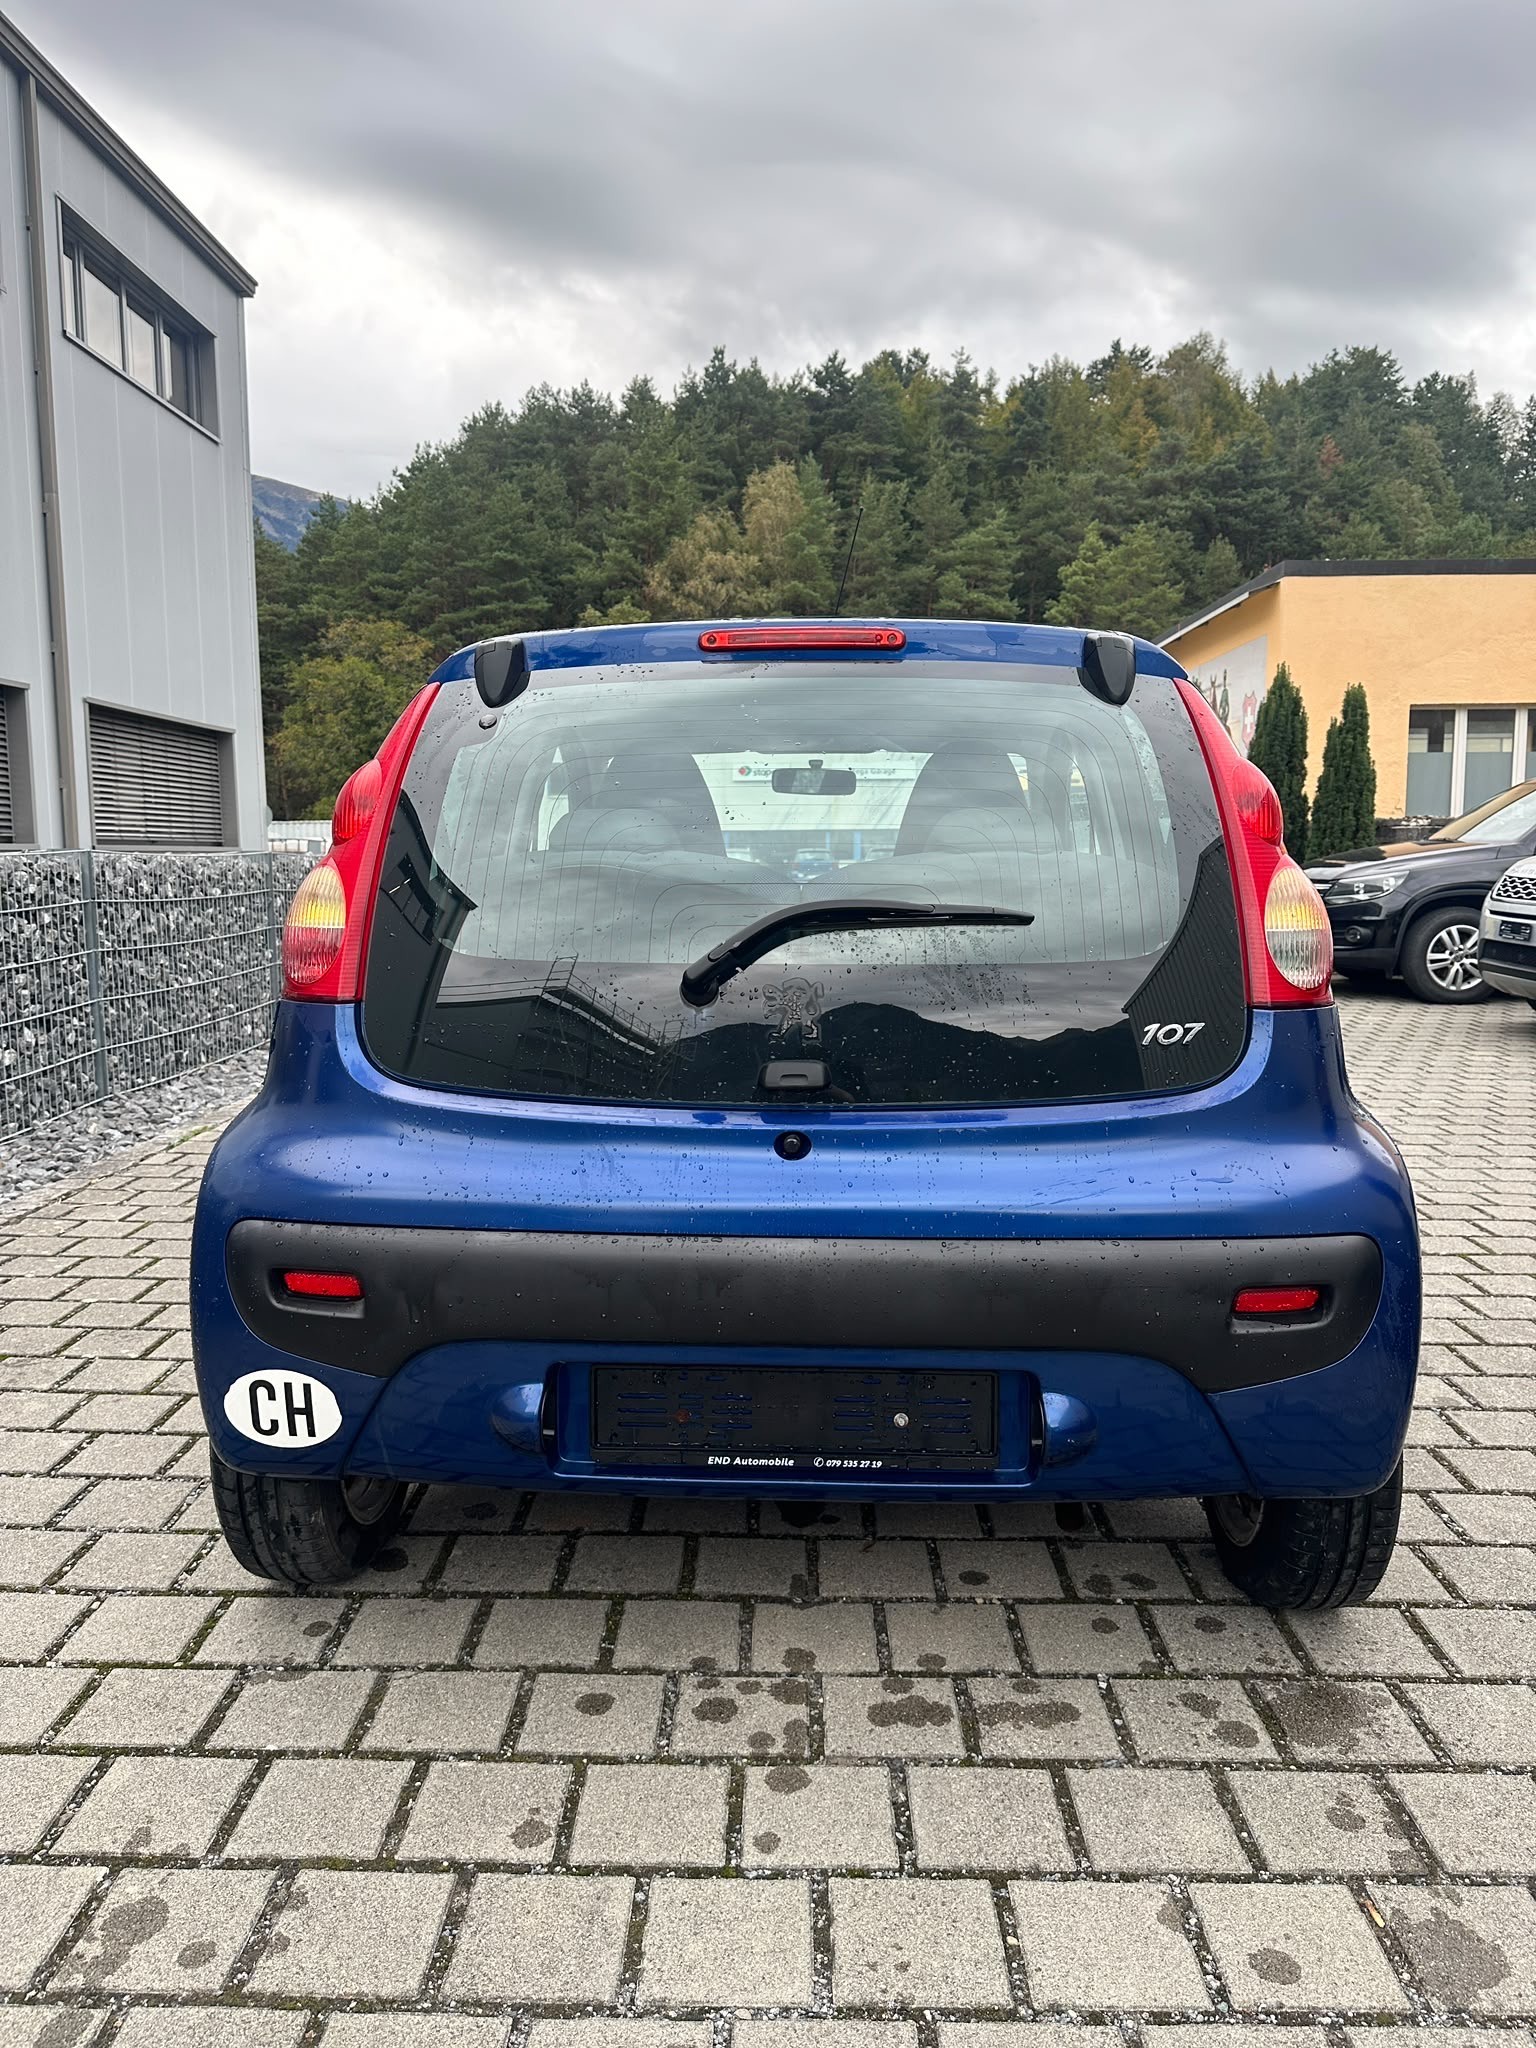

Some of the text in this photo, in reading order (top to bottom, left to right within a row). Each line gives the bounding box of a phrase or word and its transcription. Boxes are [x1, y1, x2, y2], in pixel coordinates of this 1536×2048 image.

[1142, 1022, 1206, 1046] 107
[249, 1379, 317, 1438] CH
[707, 1456, 882, 1468] END Automobile 079 535 27 19
